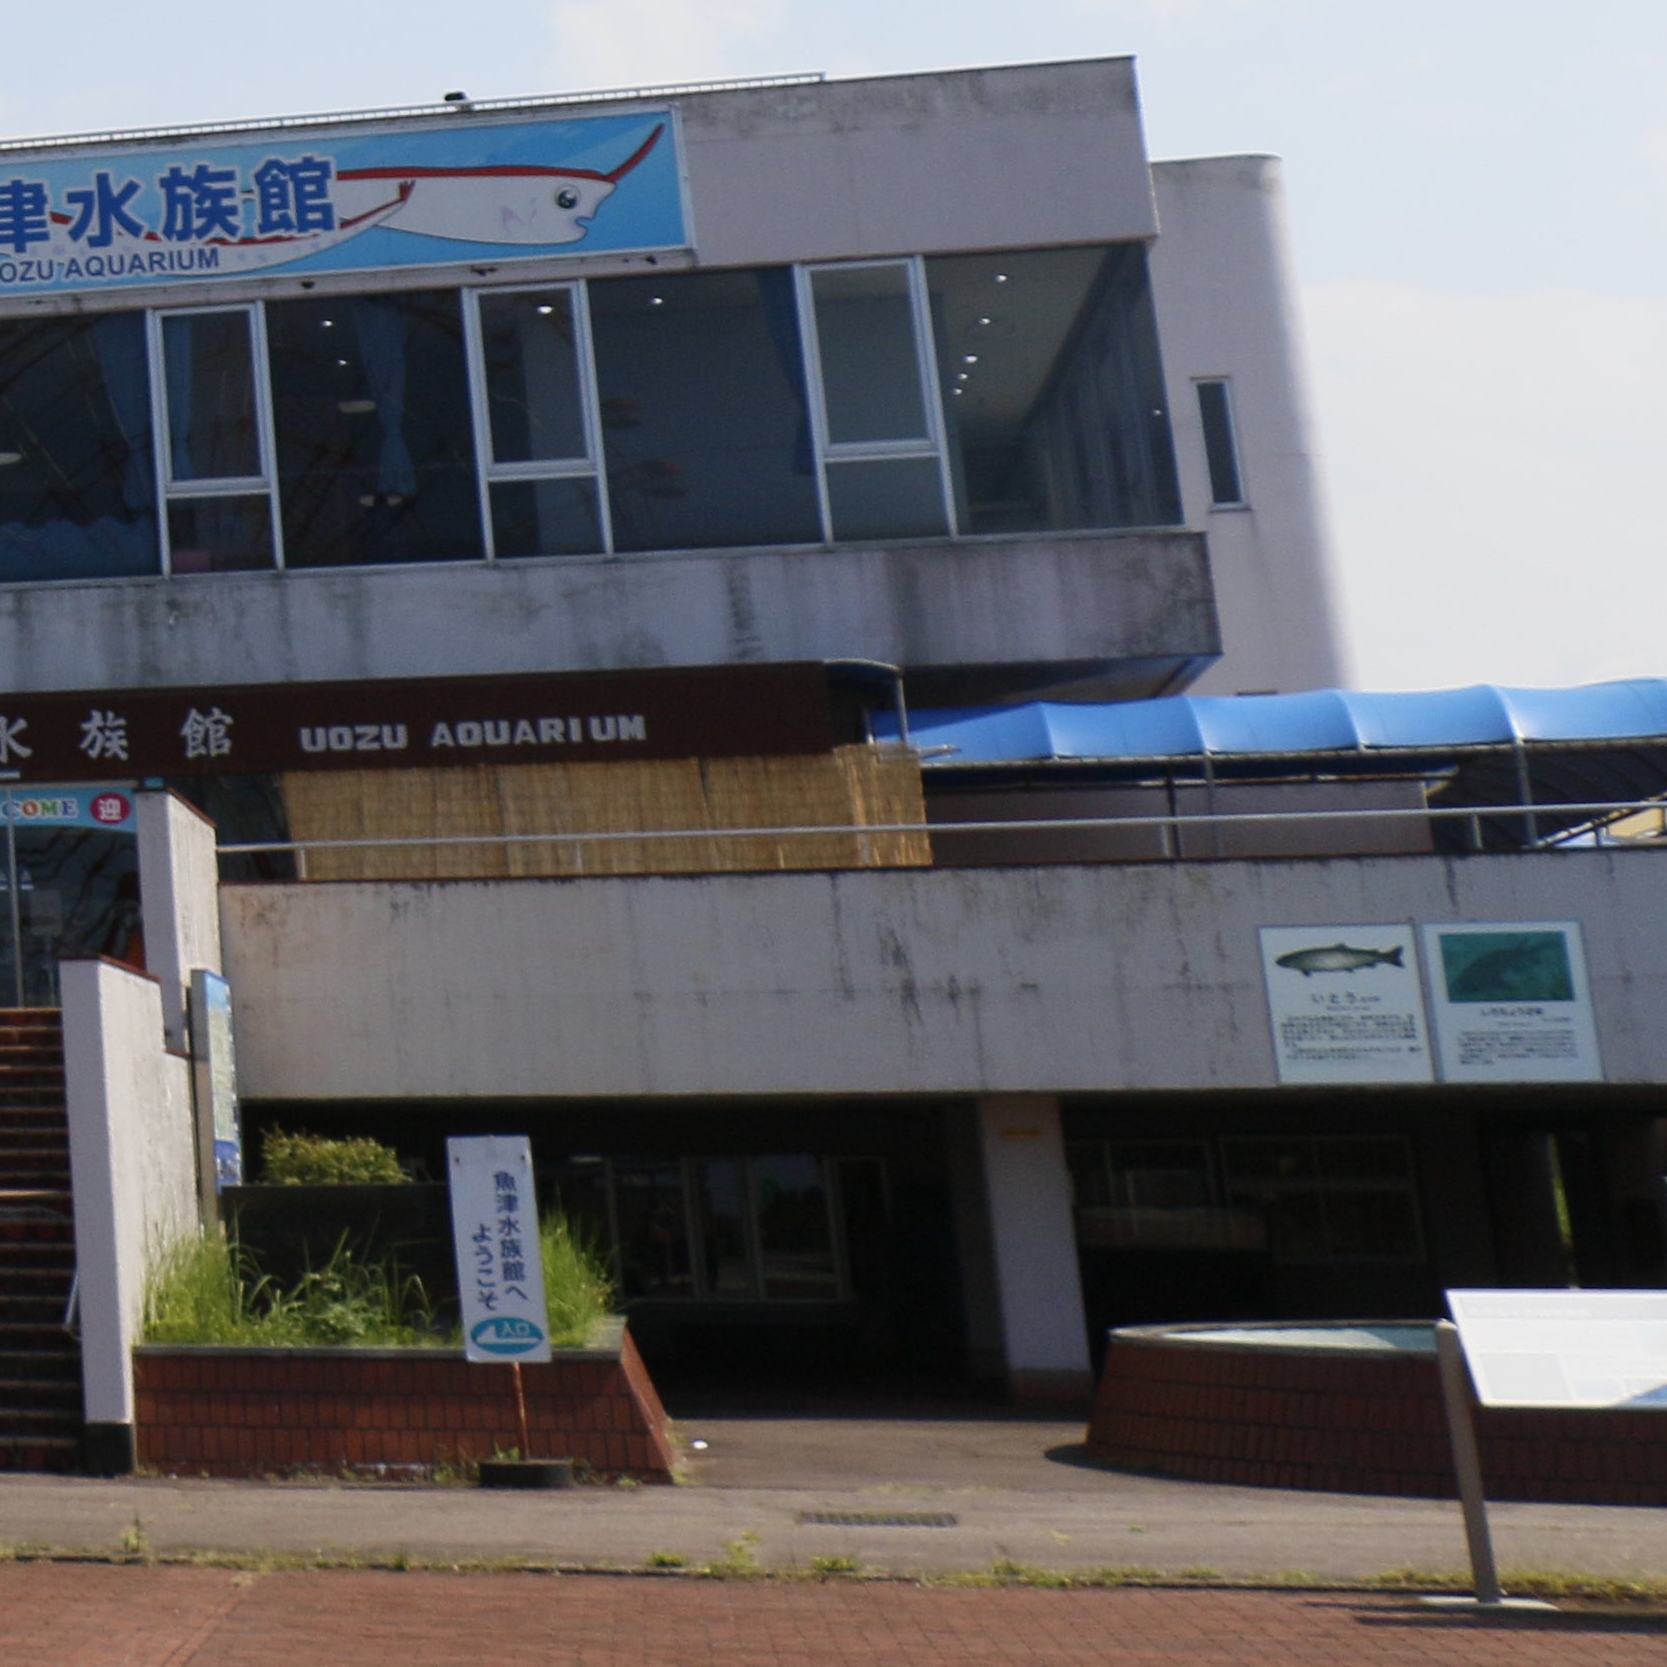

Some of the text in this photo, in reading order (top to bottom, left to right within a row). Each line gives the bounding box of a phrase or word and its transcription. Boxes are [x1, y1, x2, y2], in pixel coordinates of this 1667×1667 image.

[67, 247, 220, 277] AQUARIUM
[300, 714, 647, 753] UOZU AQUARIUM
[493, 1170, 528, 1301] 魚津水族館へ
[471, 1223, 499, 1311] ようこそ
[501, 1320, 531, 1337] 入口
